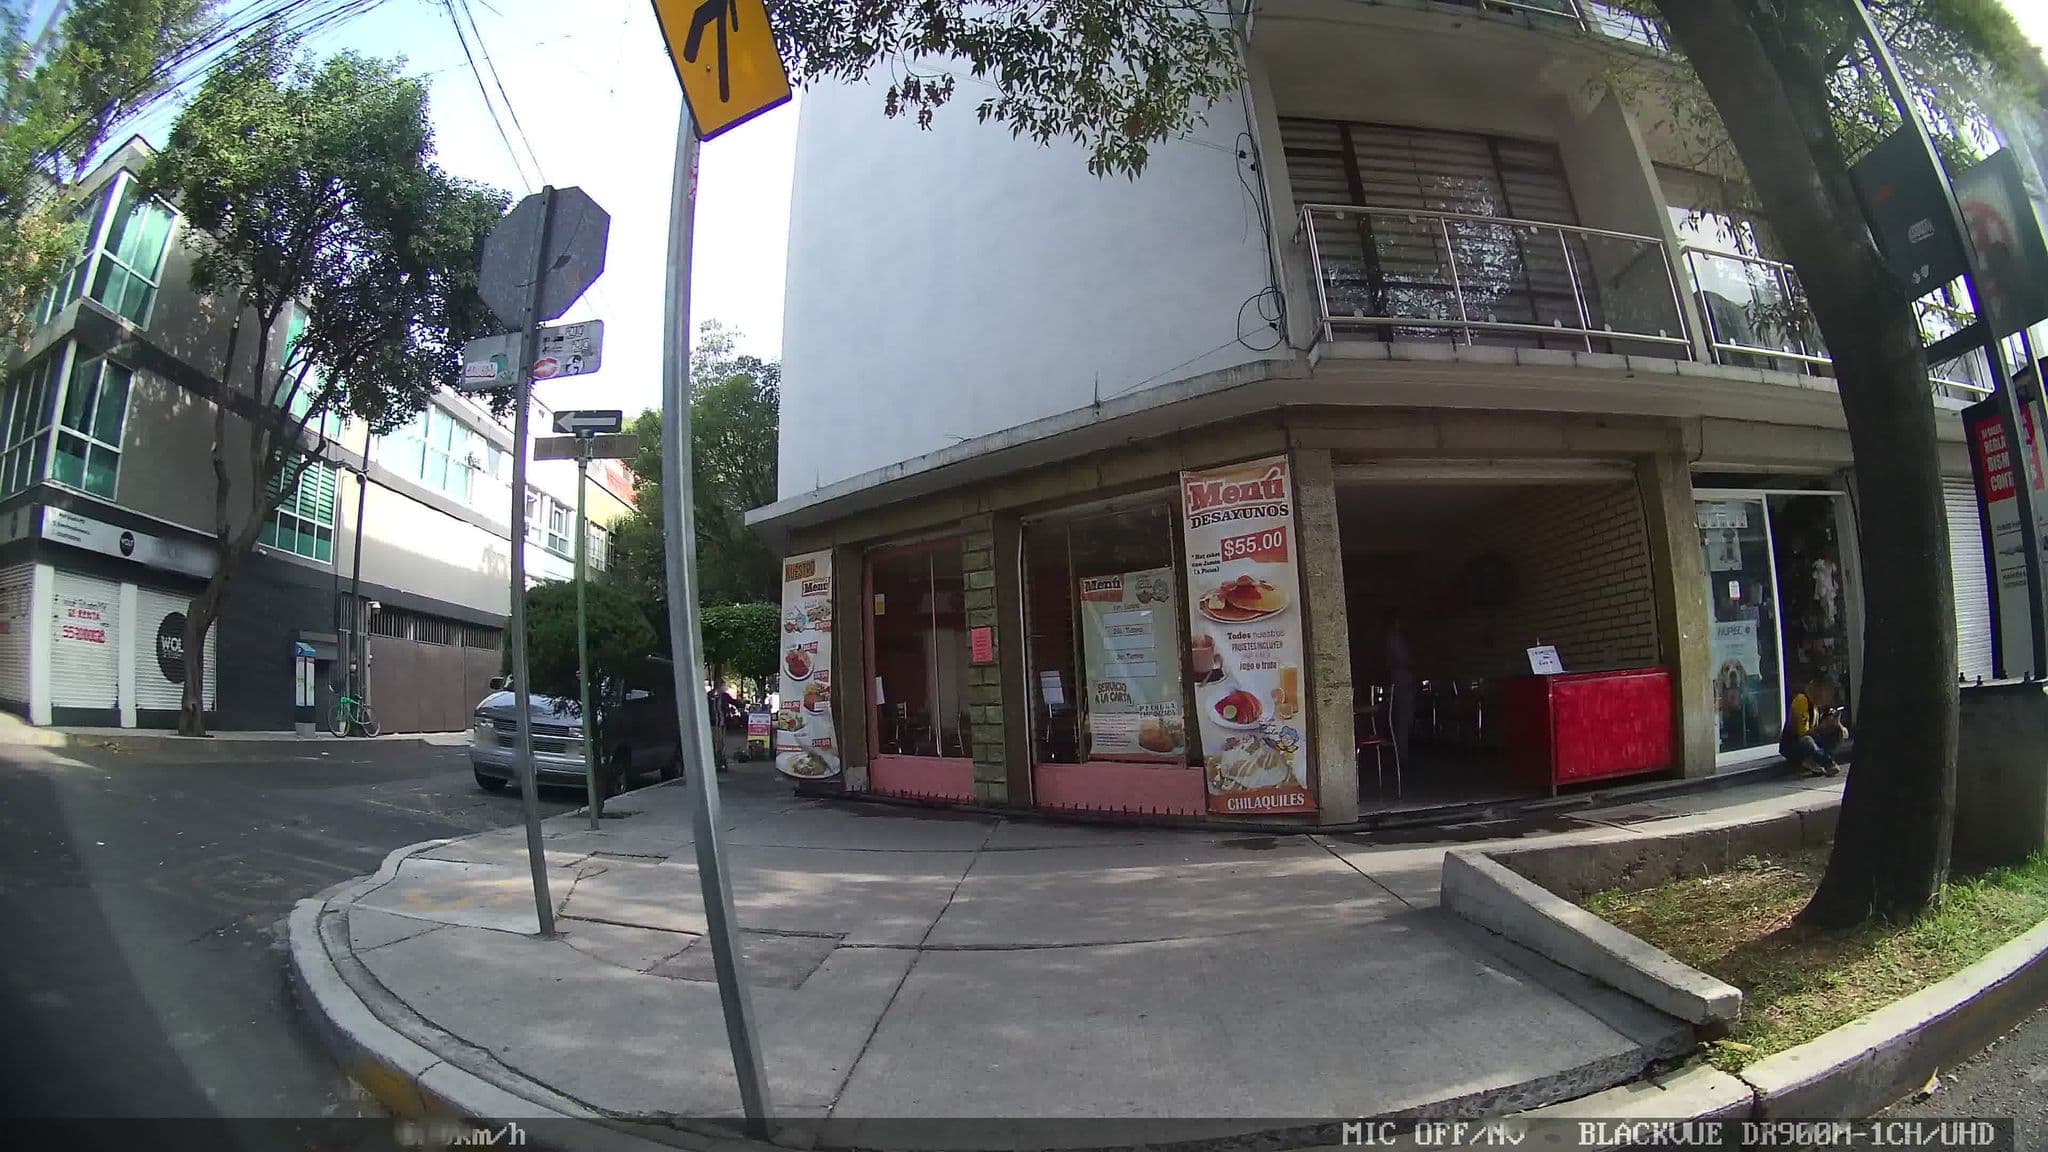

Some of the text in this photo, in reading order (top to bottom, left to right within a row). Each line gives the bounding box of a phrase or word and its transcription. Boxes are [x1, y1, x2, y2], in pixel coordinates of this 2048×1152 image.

[1189, 467, 1285, 511] Menú
[1190, 504, 1289, 529] DESAYUNOS
[1224, 531, 1282, 559] $55.00
[1085, 577, 1121, 593] Menú
[161, 636, 184, 652] WOL
[1227, 632, 1251, 640] Todos
[1098, 681, 1127, 693] SERVICIO
[1110, 691, 1132, 704] CARTA
[1227, 793, 1305, 810] CHILAQUILES
